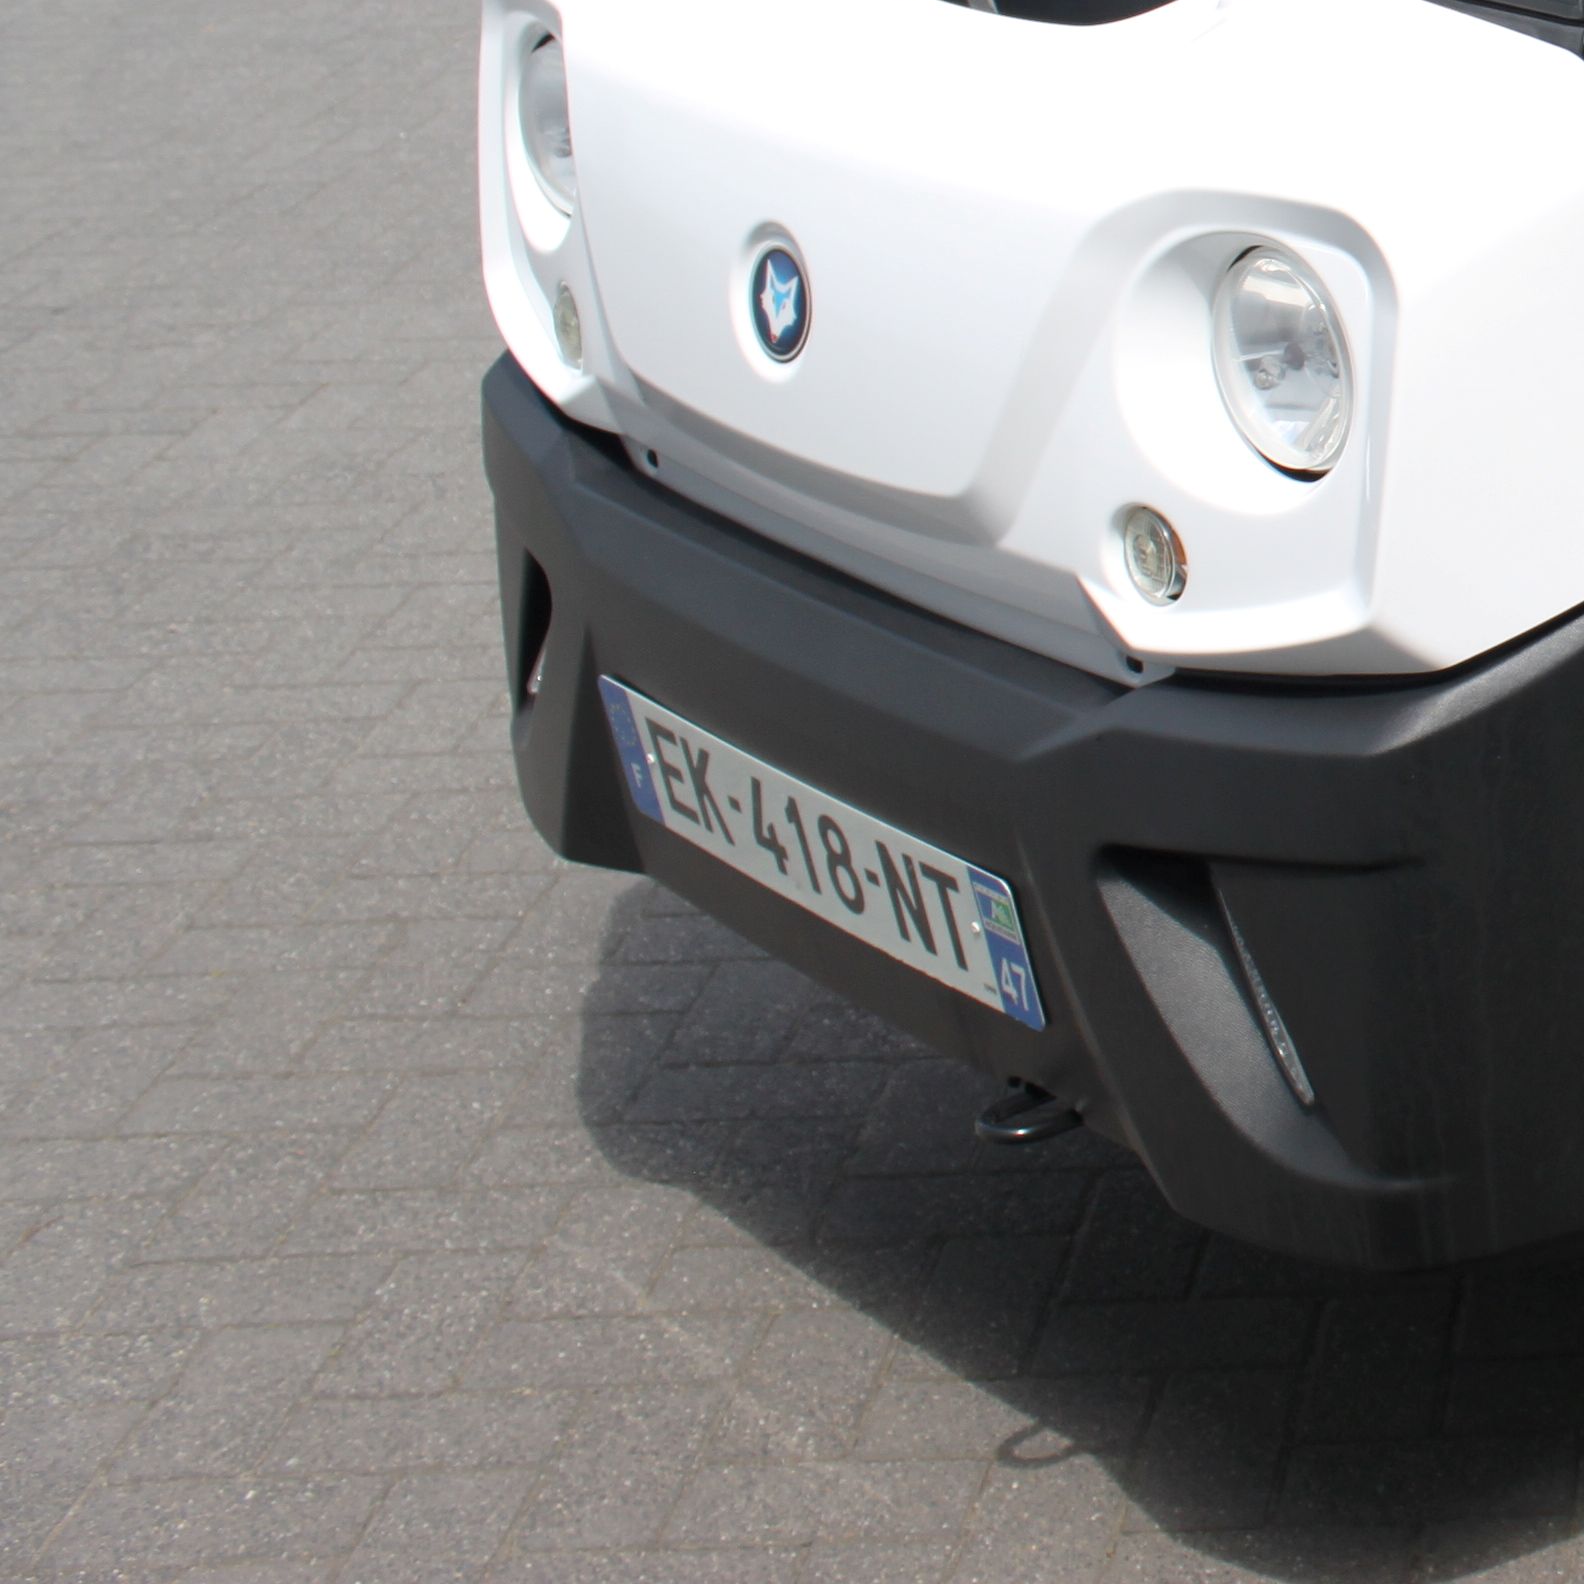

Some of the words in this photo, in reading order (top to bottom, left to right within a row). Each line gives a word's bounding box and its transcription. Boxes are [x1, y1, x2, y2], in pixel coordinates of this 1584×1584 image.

[630, 762, 643, 790] F
[645, 716, 969, 972] EK-418-NT
[1001, 957, 1029, 1012] 47
